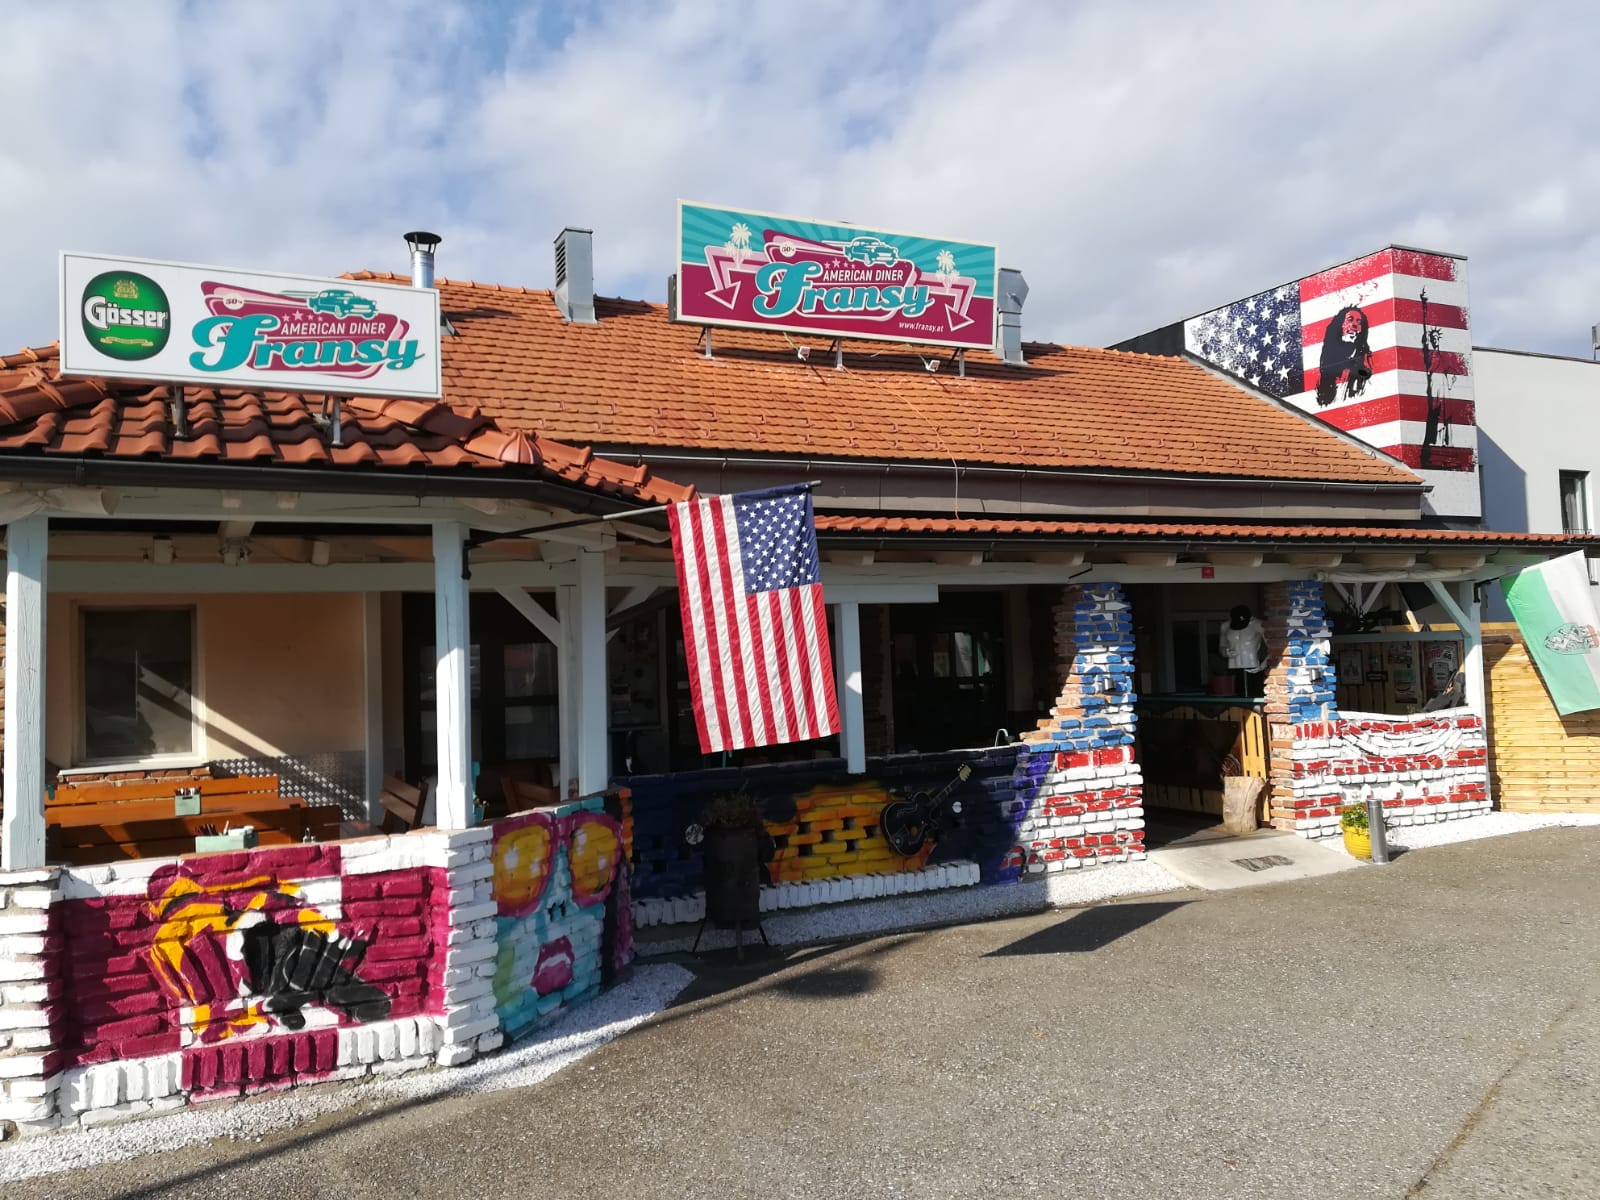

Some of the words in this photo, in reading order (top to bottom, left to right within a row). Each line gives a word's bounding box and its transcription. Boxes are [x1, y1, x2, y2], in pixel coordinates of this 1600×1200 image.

[823, 269, 872, 282] AMERICAN
[875, 270, 904, 282] DINER
[753, 261, 935, 318] Fransy
[84, 295, 167, 329] Gösser
[281, 321, 345, 335] AMERICAN
[349, 322, 386, 335] DINER
[899, 321, 944, 332] www.fransy.at
[189, 313, 425, 372] Fransy
